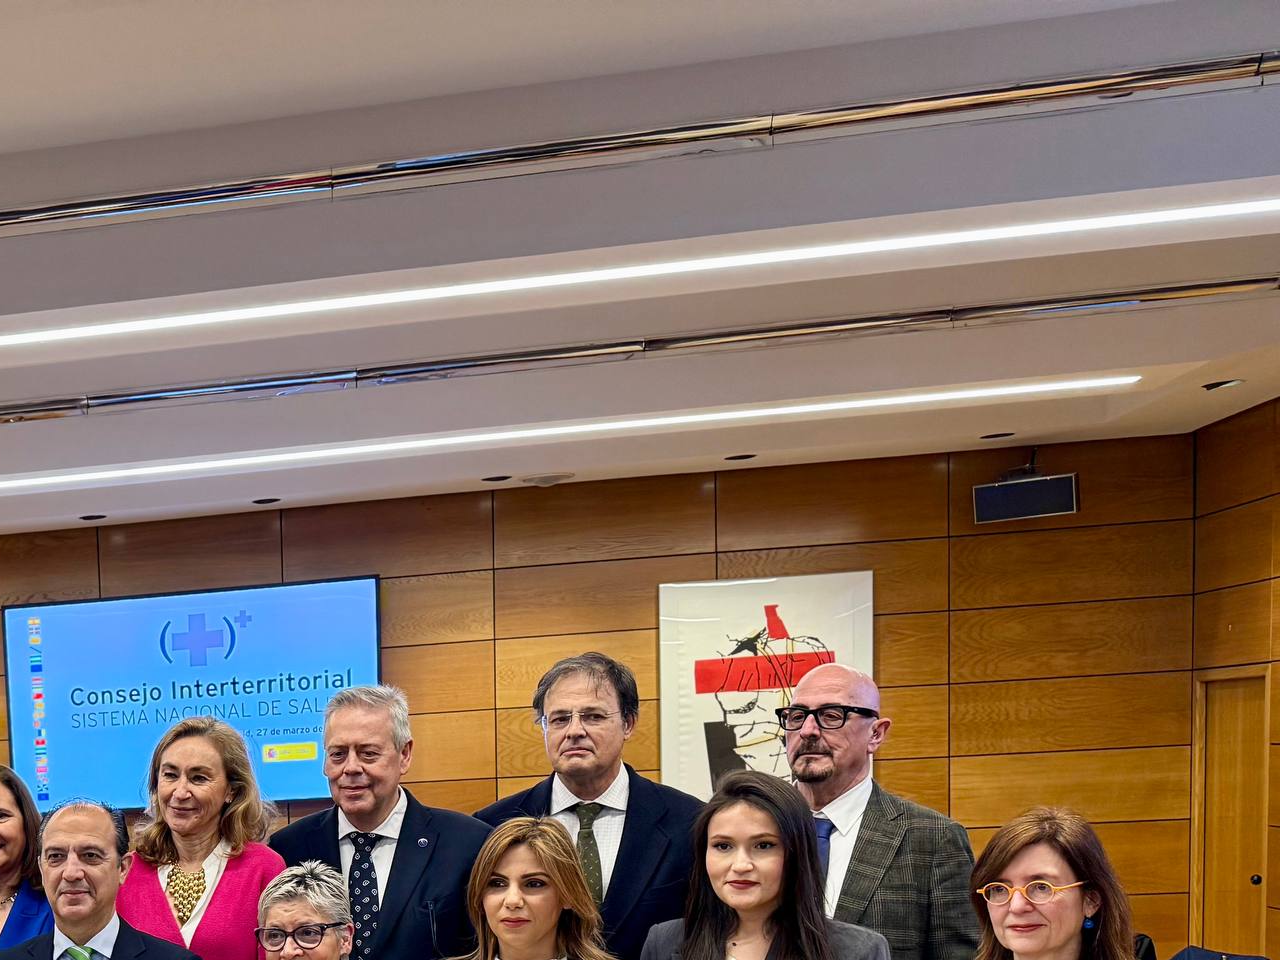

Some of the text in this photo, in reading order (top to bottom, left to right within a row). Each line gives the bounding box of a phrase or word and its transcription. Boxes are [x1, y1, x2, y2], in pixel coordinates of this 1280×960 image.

[71, 668, 352, 706] Consejo Interterritorial
[71, 697, 330, 729] SISTEMA NACIONAL DE SAL
[256, 728, 268, 737] 27
[270, 728, 281, 736] de
[283, 726, 310, 735] marzo
[312, 725, 323, 733] de
